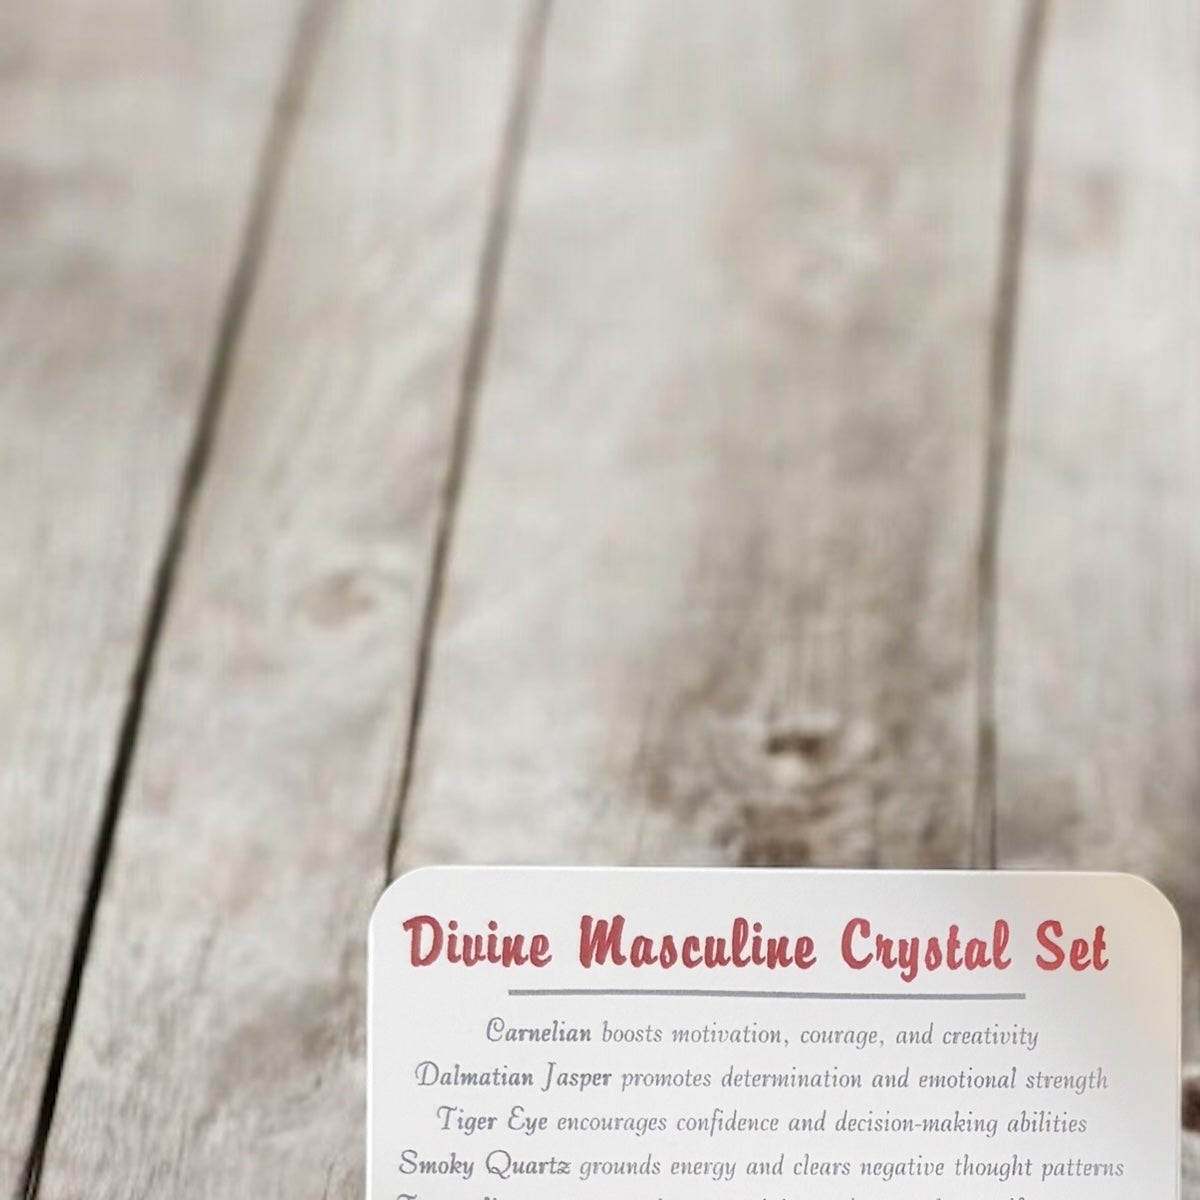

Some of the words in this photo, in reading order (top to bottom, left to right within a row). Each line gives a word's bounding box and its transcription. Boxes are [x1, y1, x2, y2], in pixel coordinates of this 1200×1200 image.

[401, 914, 553, 968] Divine
[578, 914, 818, 970] Masculine
[840, 917, 1012, 984] Crystal
[1035, 919, 1110, 972] Set
[485, 1016, 592, 1043] Carnelian
[601, 1019, 664, 1043] boosts
[671, 1021, 790, 1048] motivation,
[799, 1029, 885, 1051] courage,
[895, 1021, 934, 1045] and
[941, 1023, 1040, 1052] creativity
[413, 1060, 535, 1087] Dalmatian
[540, 1061, 613, 1093] Jasper
[620, 1068, 712, 1093] promotes
[720, 1064, 863, 1089] determination
[871, 1065, 910, 1089] and
[918, 1065, 1017, 1089] emotional
[1025, 1066, 1109, 1096] strength
[435, 1104, 499, 1137] Tiger
[506, 1104, 549, 1137] Eye
[556, 1116, 668, 1138] encourages
[676, 1107, 780, 1138] confidence
[787, 1108, 827, 1132] and
[834, 1108, 999, 1139] decision-making
[1006, 1109, 1088, 1134] abilities
[397, 1148, 475, 1181] Smoky
[484, 1149, 572, 1181] Quartz
[578, 1152, 662, 1182] grounds
[670, 1161, 737, 1182] energy
[745, 1152, 785, 1176] and
[792, 1152, 852, 1176] clears
[859, 1154, 945, 1183] negative
[954, 1153, 1033, 1183] thought
[1041, 1157, 1125, 1183] patterns
